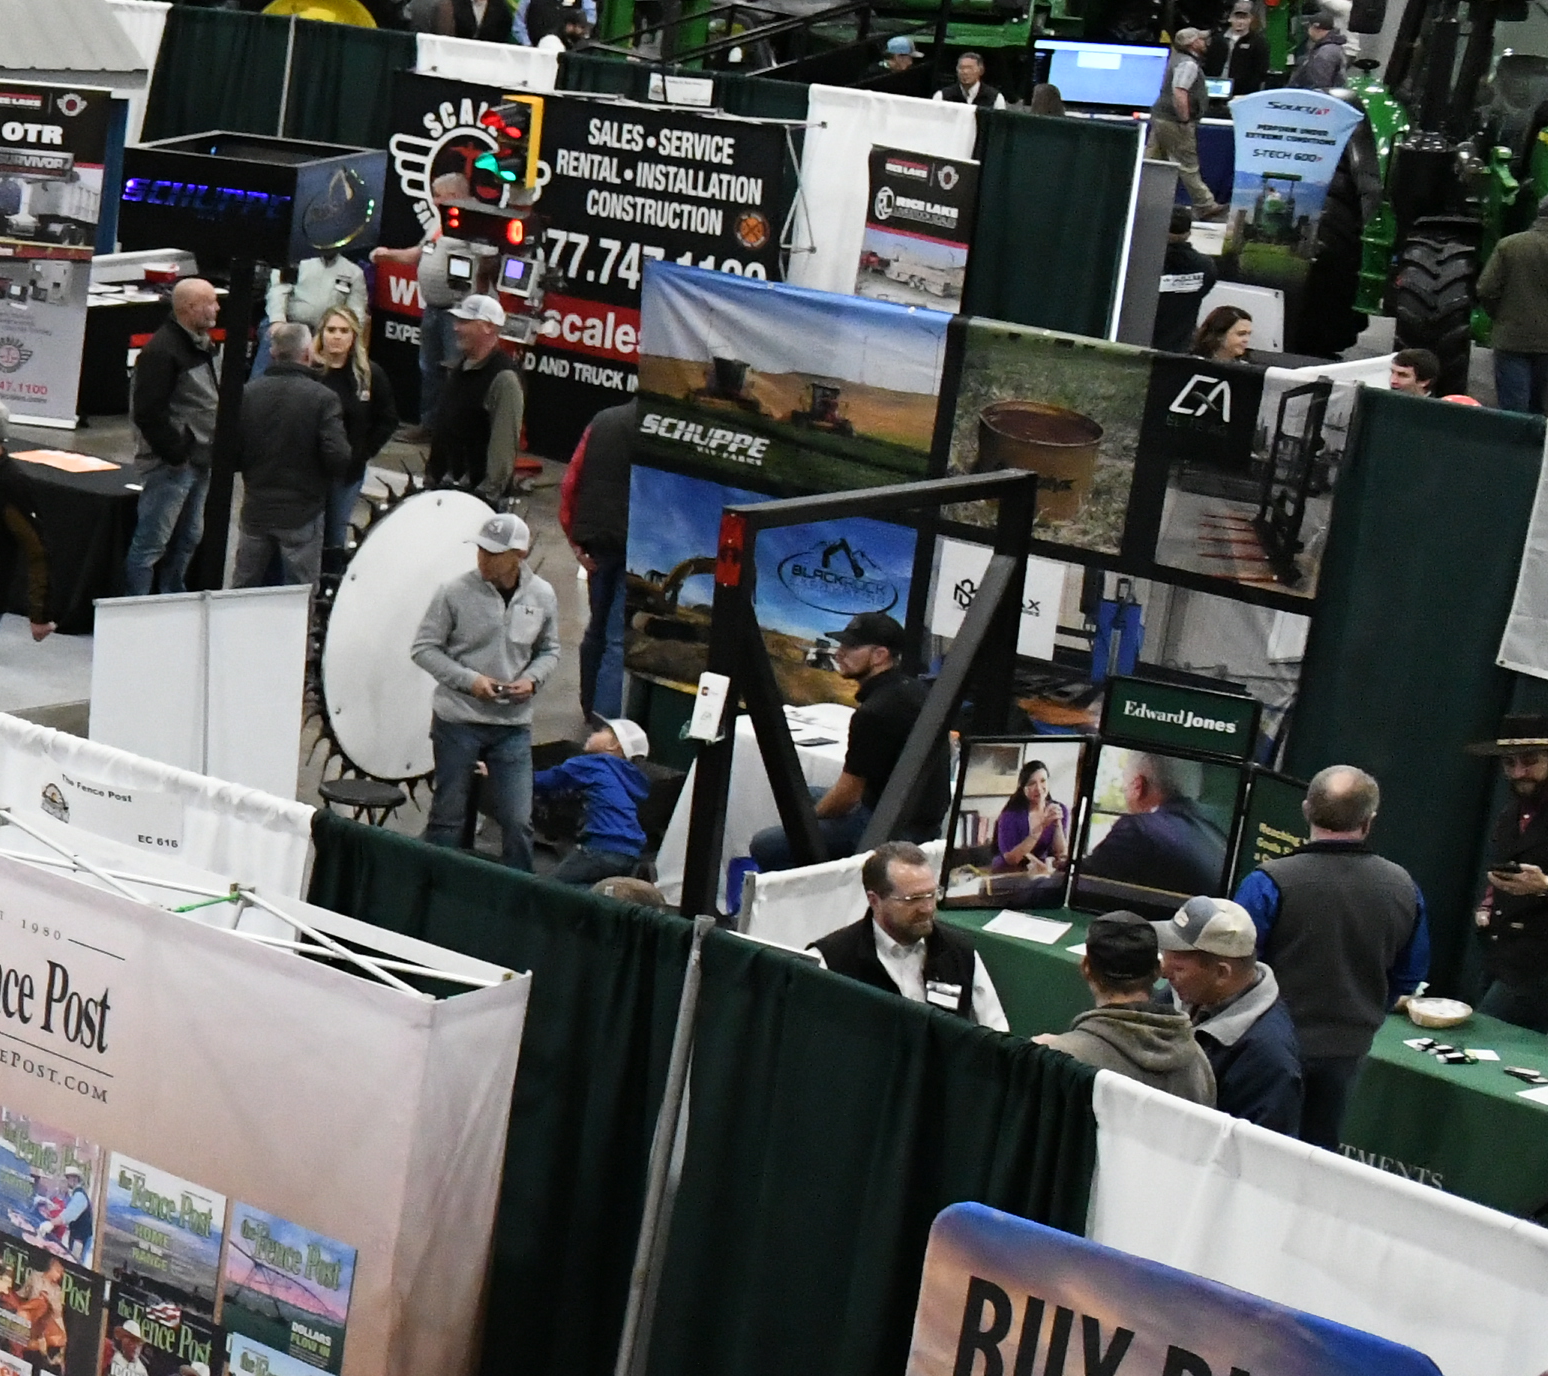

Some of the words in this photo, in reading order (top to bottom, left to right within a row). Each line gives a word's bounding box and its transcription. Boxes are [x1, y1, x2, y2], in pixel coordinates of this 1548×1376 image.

[1, 122, 63, 146] OTR
[588, 118, 643, 151] SALES
[659, 128, 734, 165] SERVICE
[557, 149, 621, 183] RENTAL
[636, 161, 762, 205] INSTALLATION
[586, 189, 722, 236] CONSTRUCTION
[897, 196, 923, 211] RICE
[925, 202, 958, 219] LAKE
[538, 357, 569, 378] AND
[573, 363, 623, 390] TRUCK
[1123, 698, 1184, 727] Edward
[1184, 707, 1237, 734] Jones
[62, 773, 74, 788] The
[76, 781, 105, 799] Fence
[108, 791, 132, 803] Post
[138, 834, 153, 845] EC
[157, 837, 179, 848] 616
[40, 960, 111, 1054] Post
[291, 1322, 332, 1347] DOLLARS
